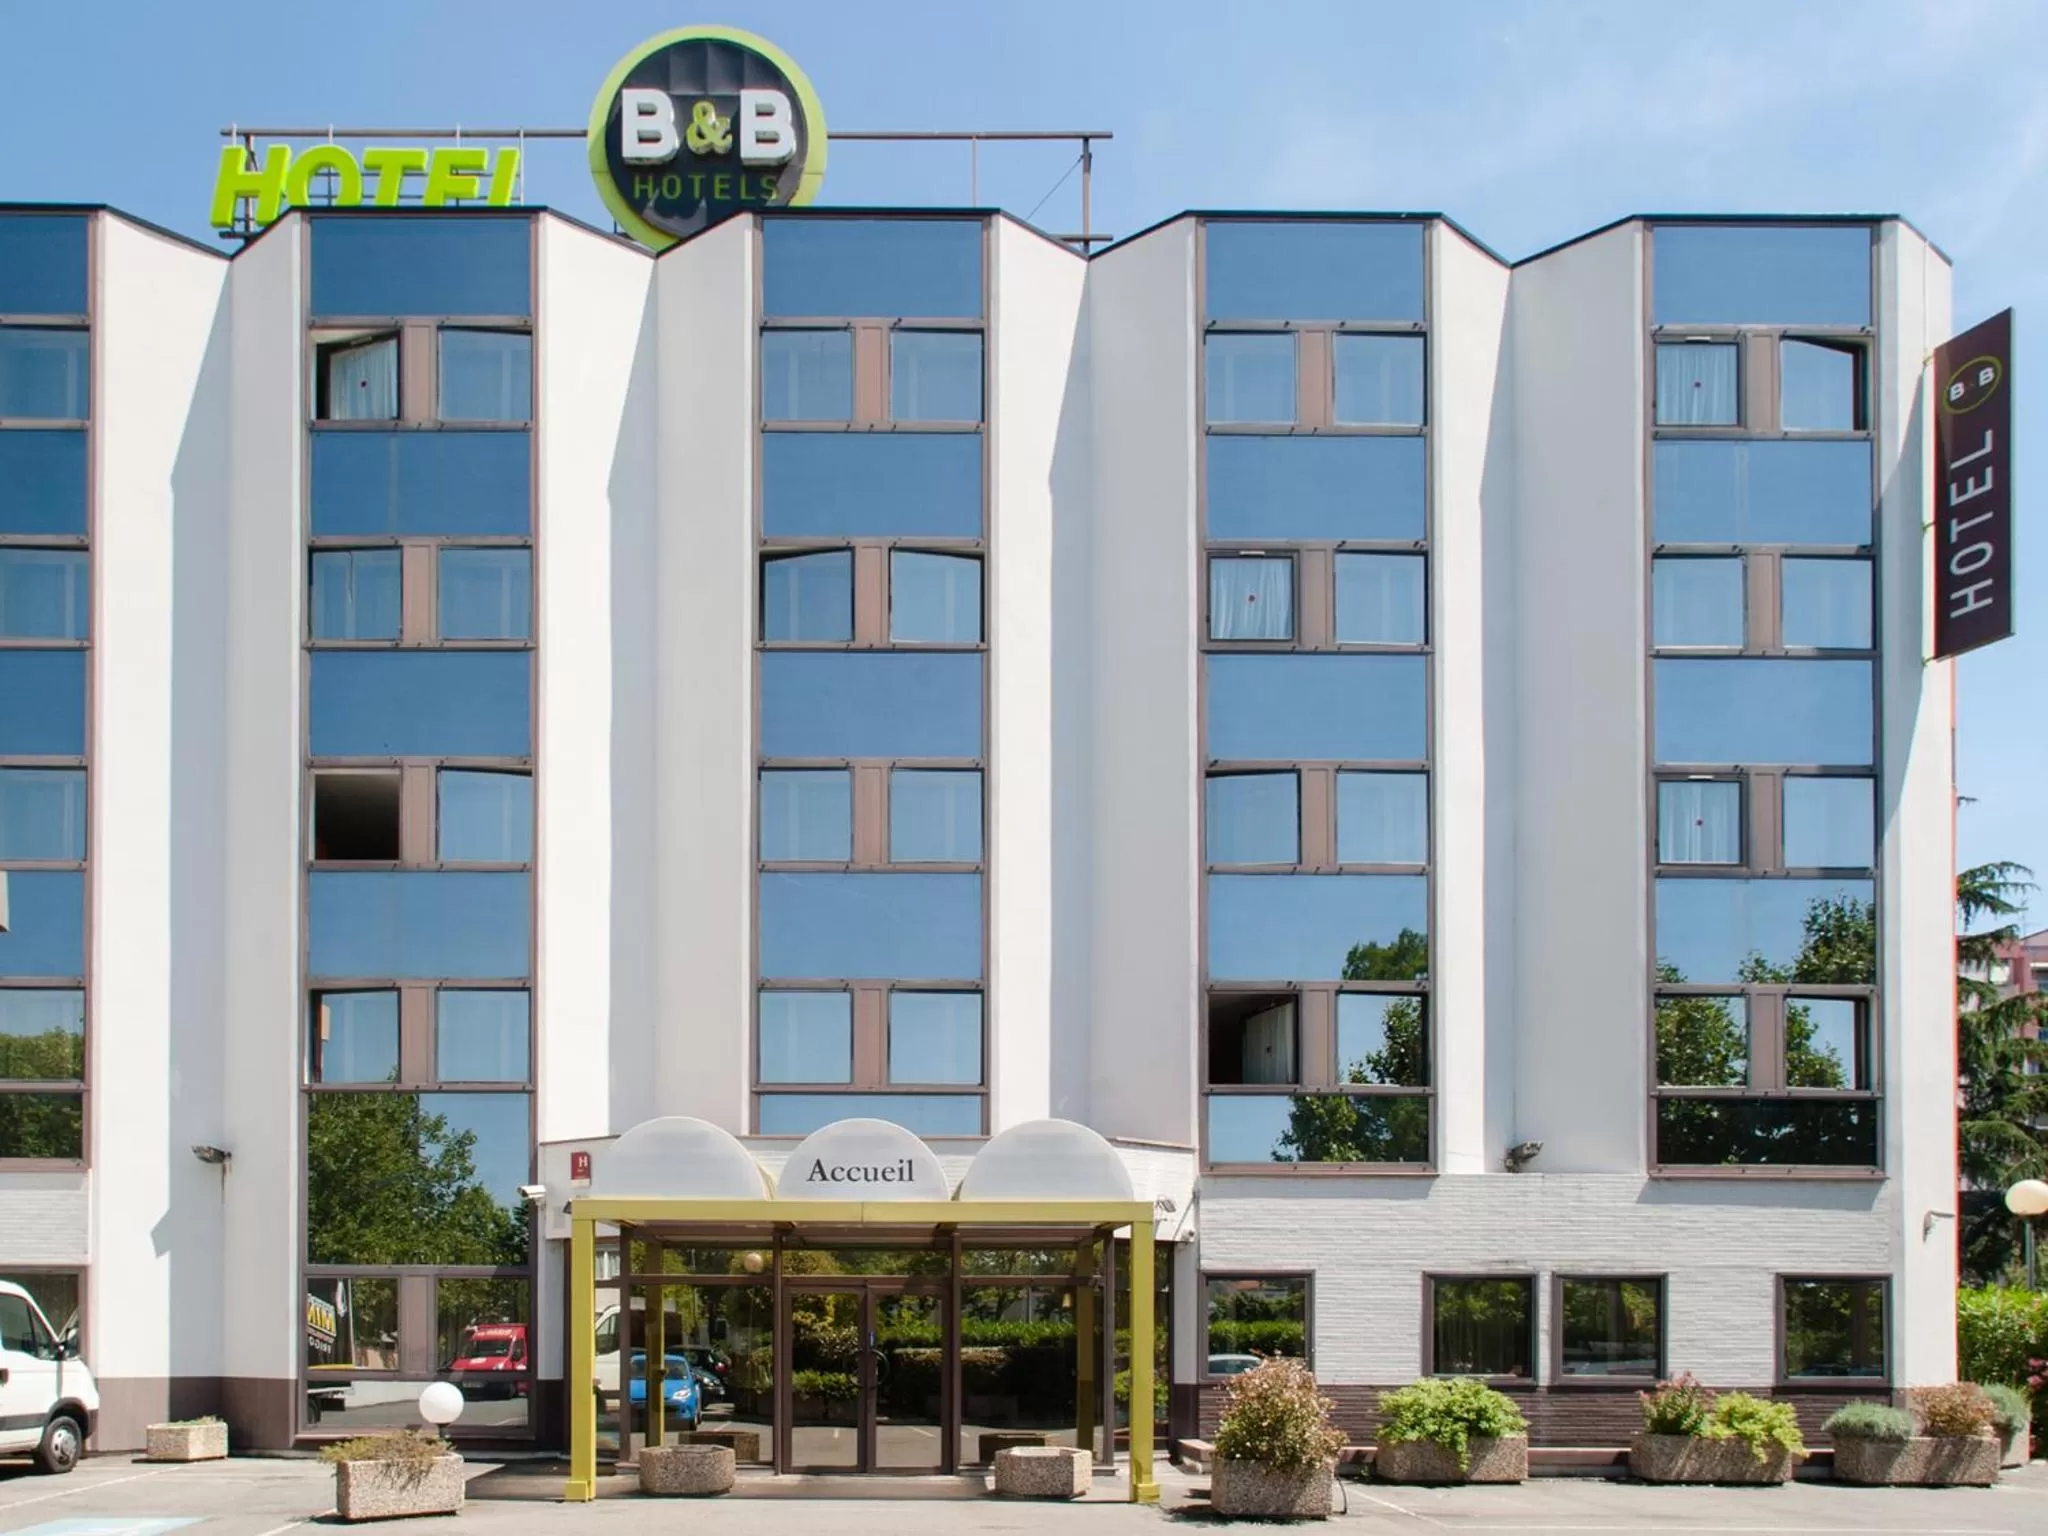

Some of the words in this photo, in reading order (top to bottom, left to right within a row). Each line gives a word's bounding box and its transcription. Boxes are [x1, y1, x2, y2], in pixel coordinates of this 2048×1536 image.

[621, 88, 797, 166] B&B
[633, 174, 781, 201] HOTELS
[1949, 429, 1994, 619] HOTEL
[806, 1158, 914, 1182] Accueil
